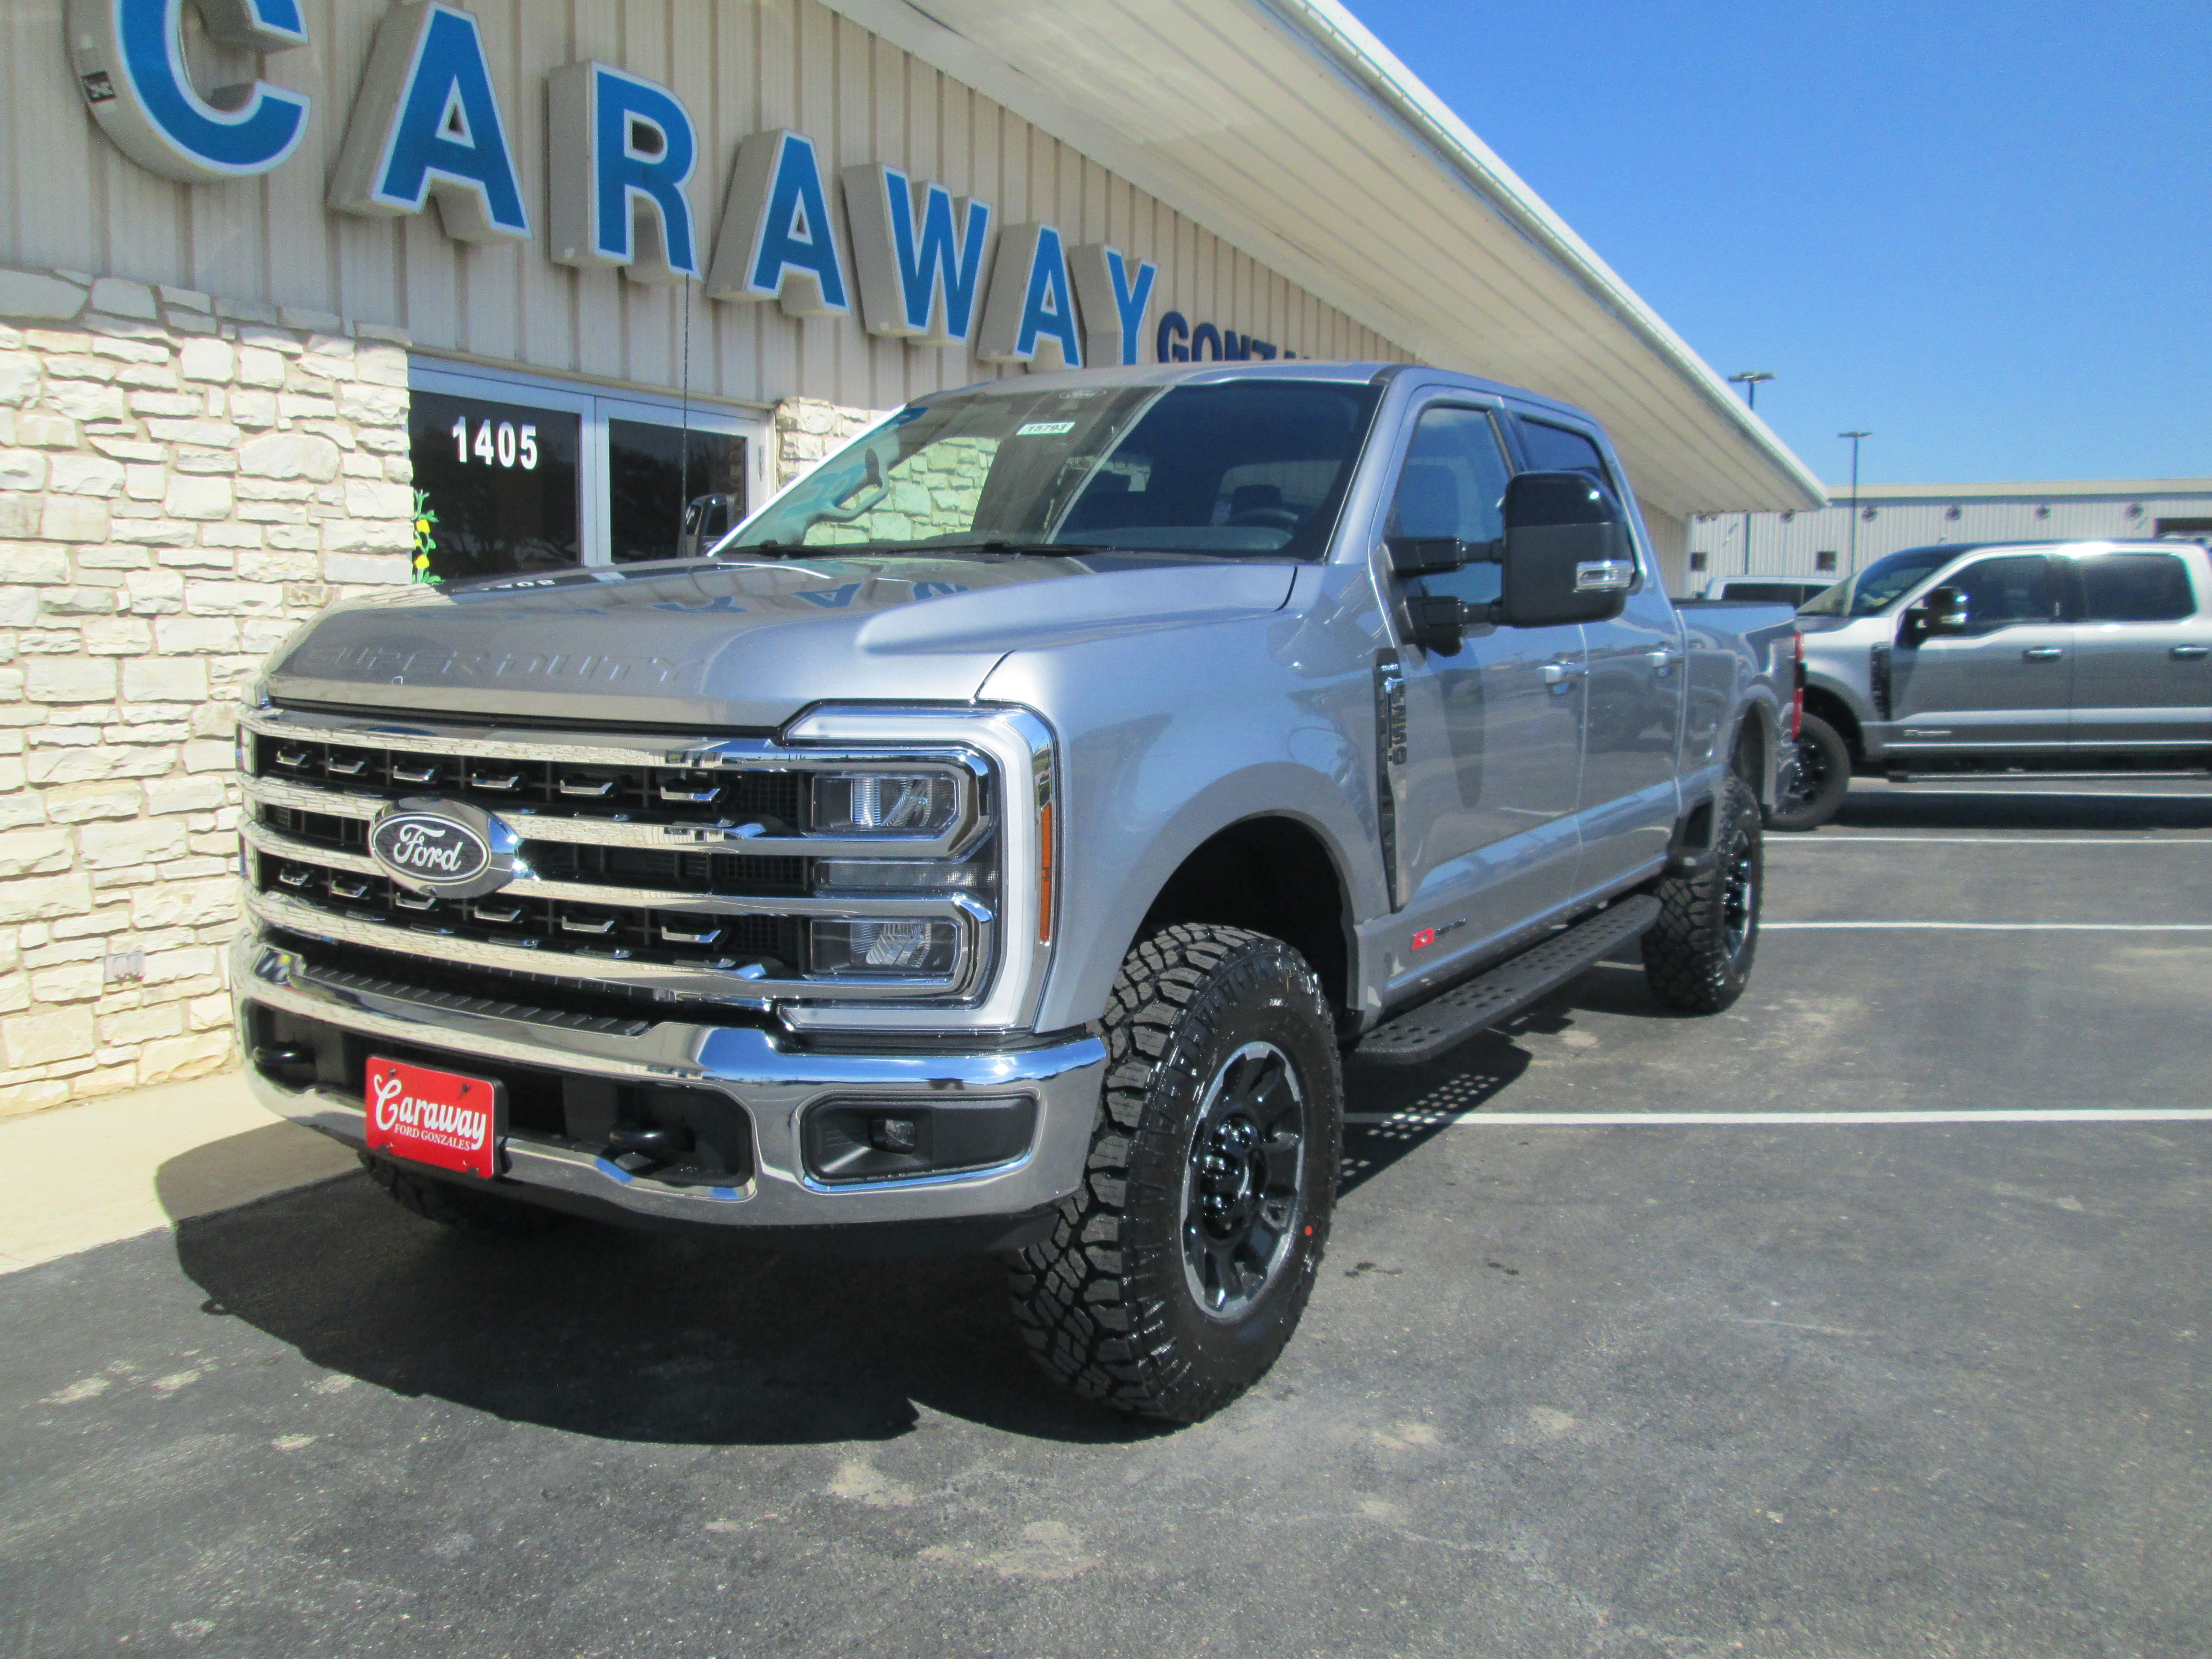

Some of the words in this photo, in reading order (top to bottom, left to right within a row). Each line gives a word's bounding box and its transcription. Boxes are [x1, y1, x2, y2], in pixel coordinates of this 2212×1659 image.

[110, 0, 1159, 371] CARAWAY
[452, 416, 538, 470] 1405
[393, 823, 464, 872] Ford
[373, 1074, 487, 1151] Caraway
[394, 1123, 420, 1138] FORD
[421, 1130, 471, 1151] GONZALES
